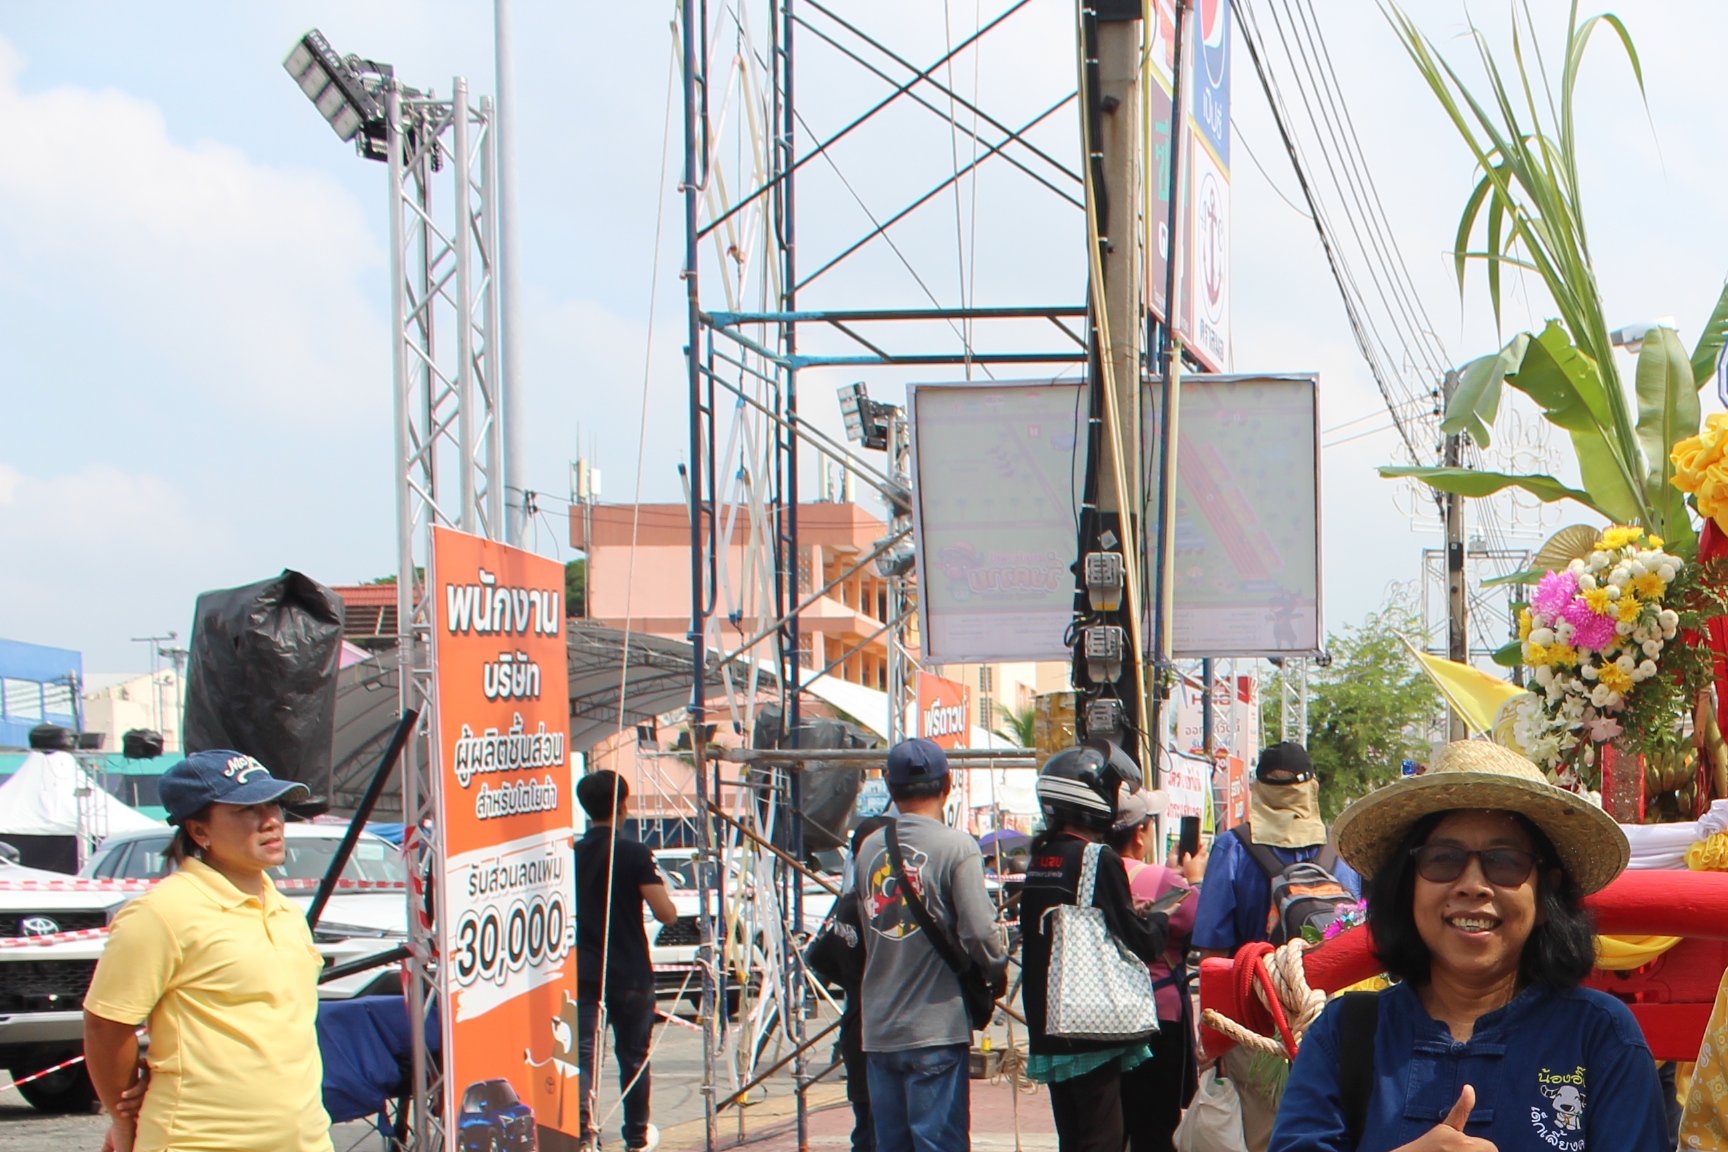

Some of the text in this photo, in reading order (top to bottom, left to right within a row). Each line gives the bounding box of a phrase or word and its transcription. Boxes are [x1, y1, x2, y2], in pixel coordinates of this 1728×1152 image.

[446, 567, 560, 635] พนักงาน
[483, 650, 541, 700] บริษัท
[454, 711, 565, 788] ผู้ผลิตชิ้นส่วน
[475, 773, 558, 820] สำหรับโตโยต้า
[468, 840, 563, 897] รับส่วนลดเพิ่ม
